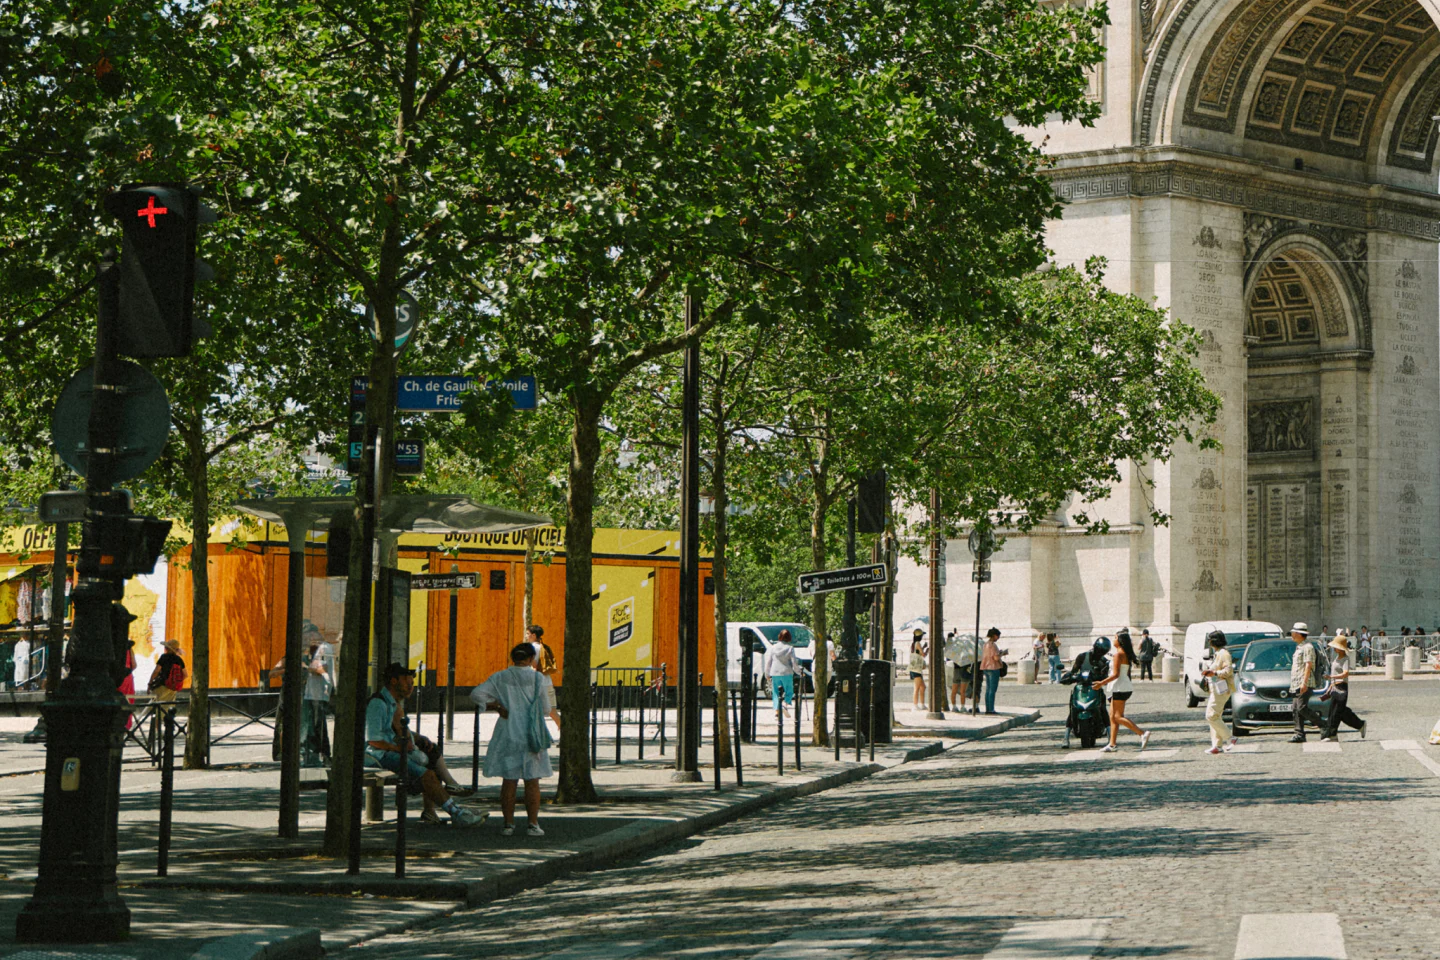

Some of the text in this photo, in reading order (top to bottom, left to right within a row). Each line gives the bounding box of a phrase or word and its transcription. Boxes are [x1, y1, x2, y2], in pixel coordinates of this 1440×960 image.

[404, 381, 423, 392] Ch.
[426, 381, 440, 392] de
[397, 444, 419, 455] N53
[827, 576, 850, 585] Toilettes
